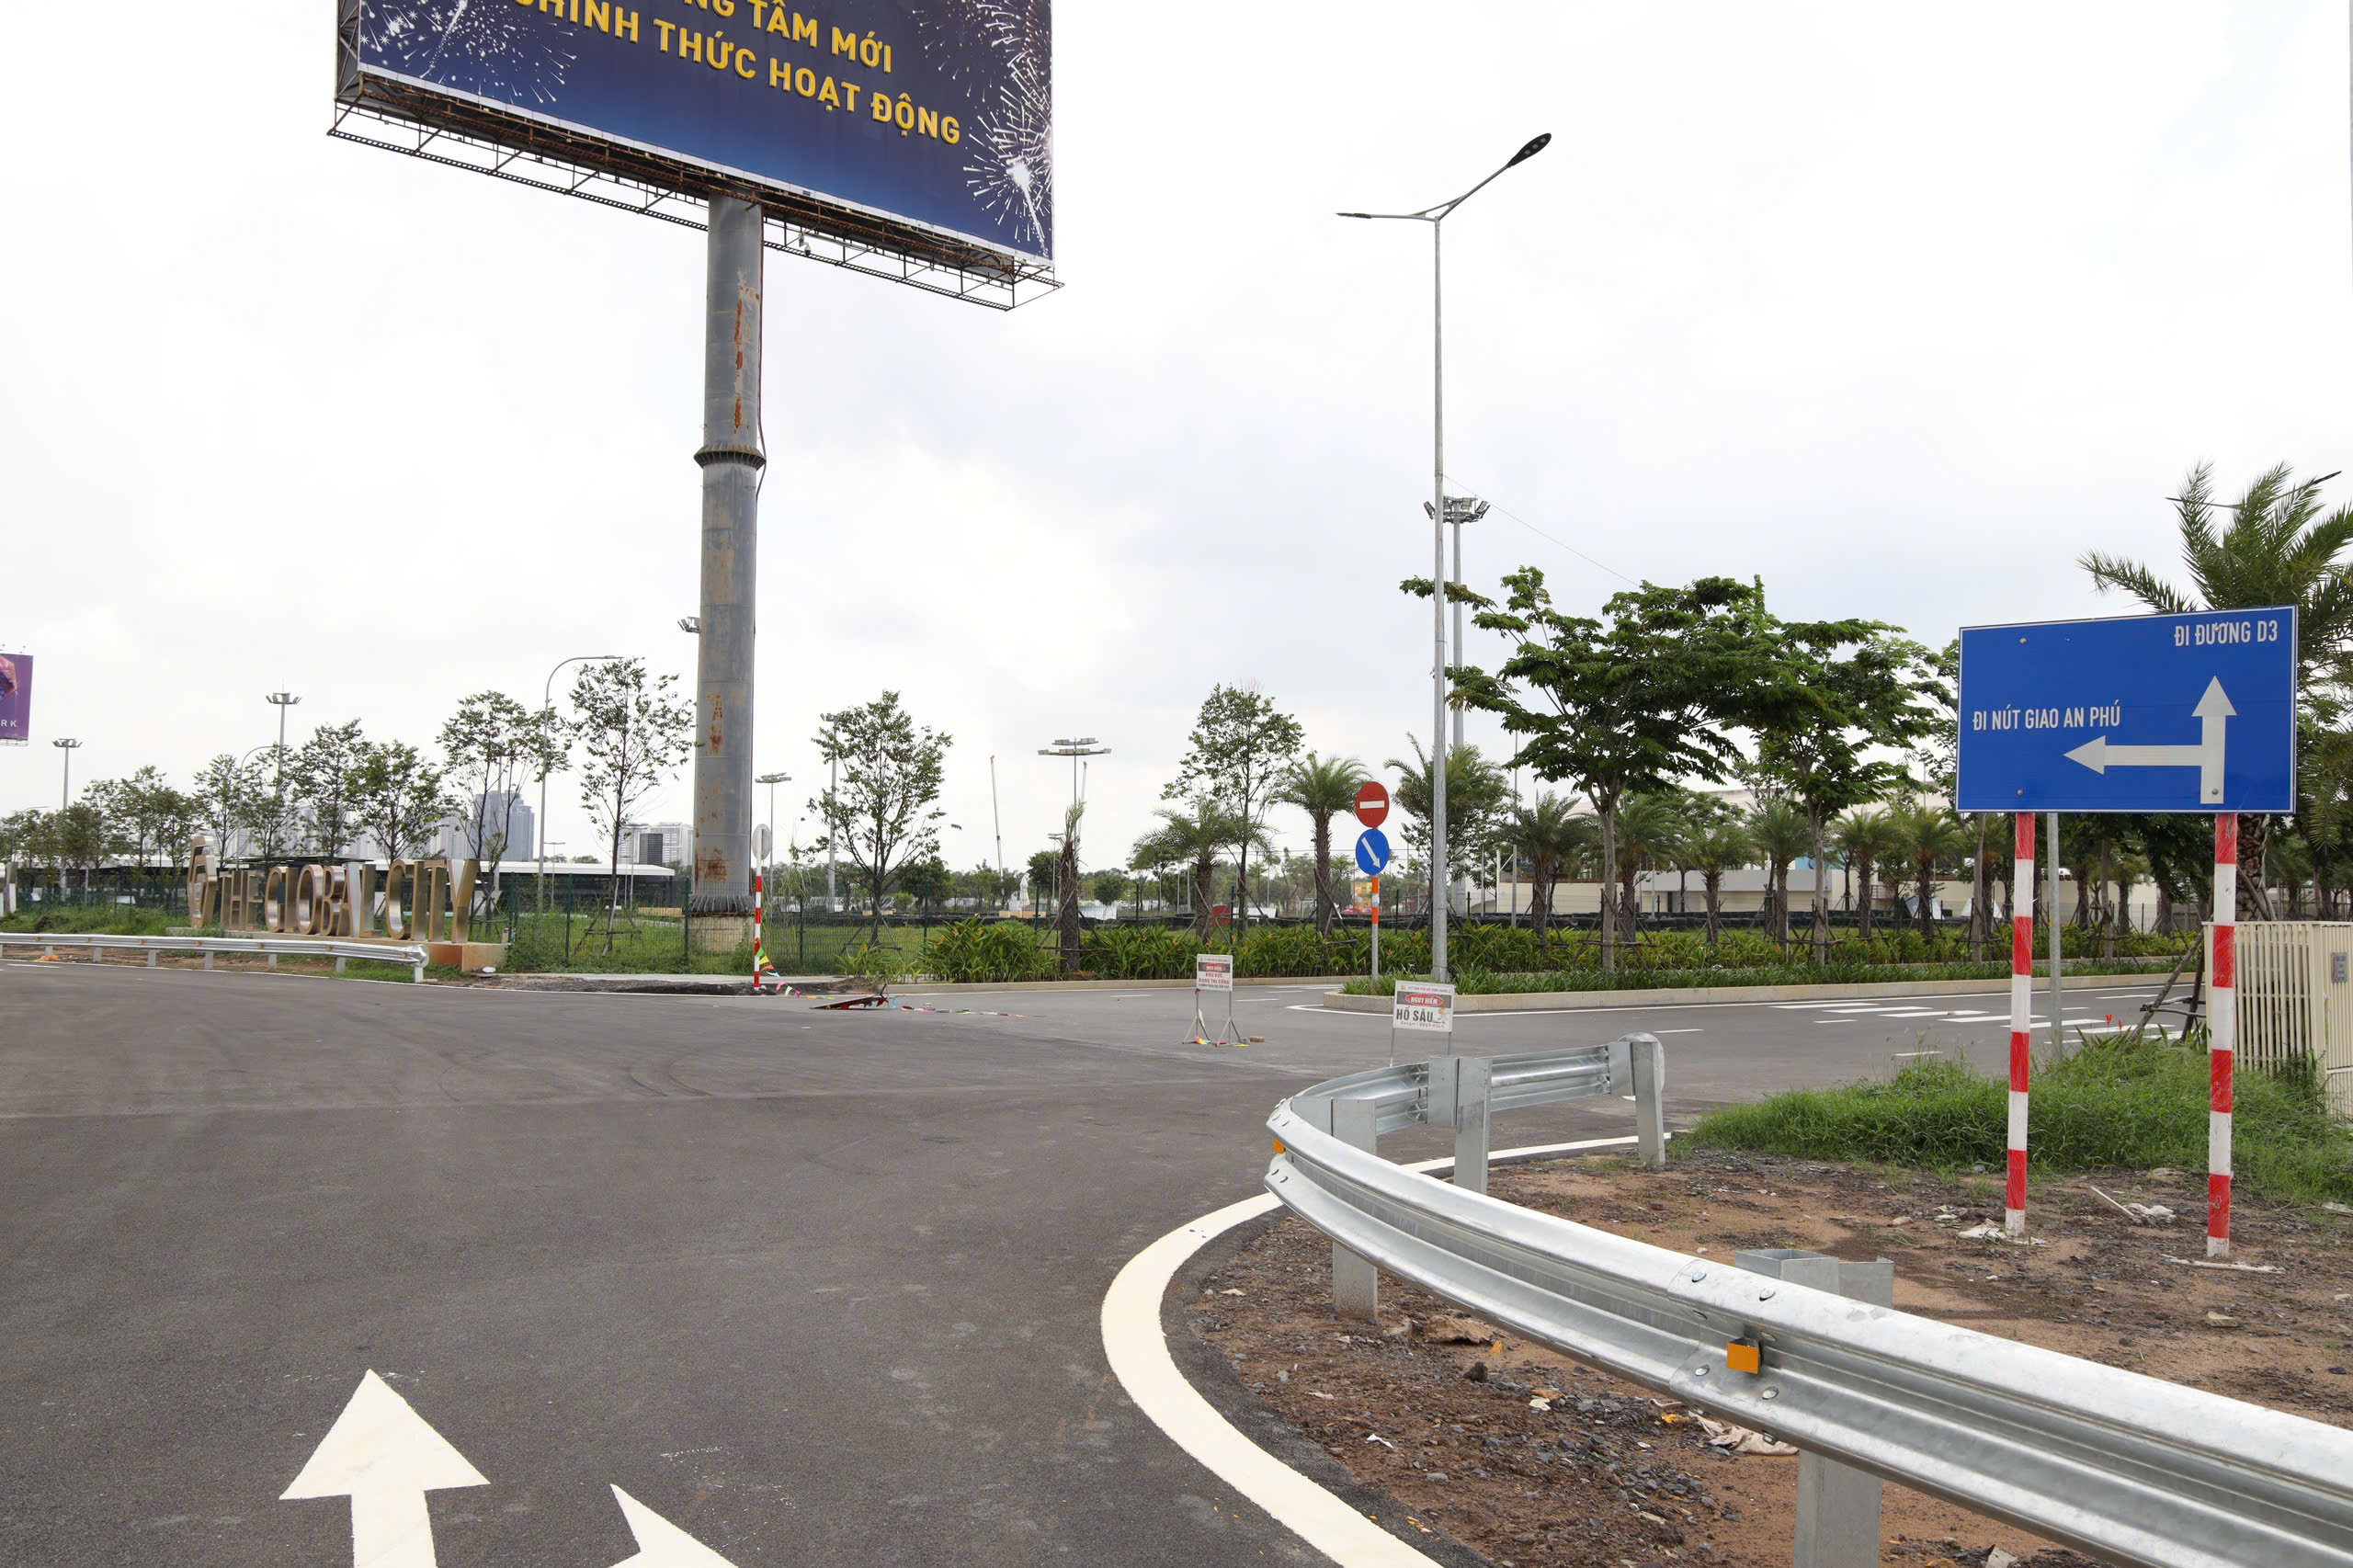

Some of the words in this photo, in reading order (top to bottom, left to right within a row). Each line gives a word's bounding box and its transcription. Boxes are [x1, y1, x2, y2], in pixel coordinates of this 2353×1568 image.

[746, 0, 817, 48] TÂM
[832, 30, 892, 74] MỚI
[654, 18, 756, 79] THỨC
[769, 57, 860, 111] HOẠT
[870, 92, 961, 144] ĐỘNG
[2174, 625, 2189, 647] ĐI
[2257, 619, 2278, 642] D3
[1972, 710, 1987, 731] ĐI
[1992, 703, 2021, 731] NÚT
[2025, 708, 2059, 729] GIAO
[2063, 707, 2085, 728] AN
[2089, 699, 2120, 728] PHÚ
[219, 869, 264, 933] THE
[264, 862, 382, 938] GLOBAL
[385, 858, 480, 944] CITY
[1413, 1008, 1433, 1022] SÂU
